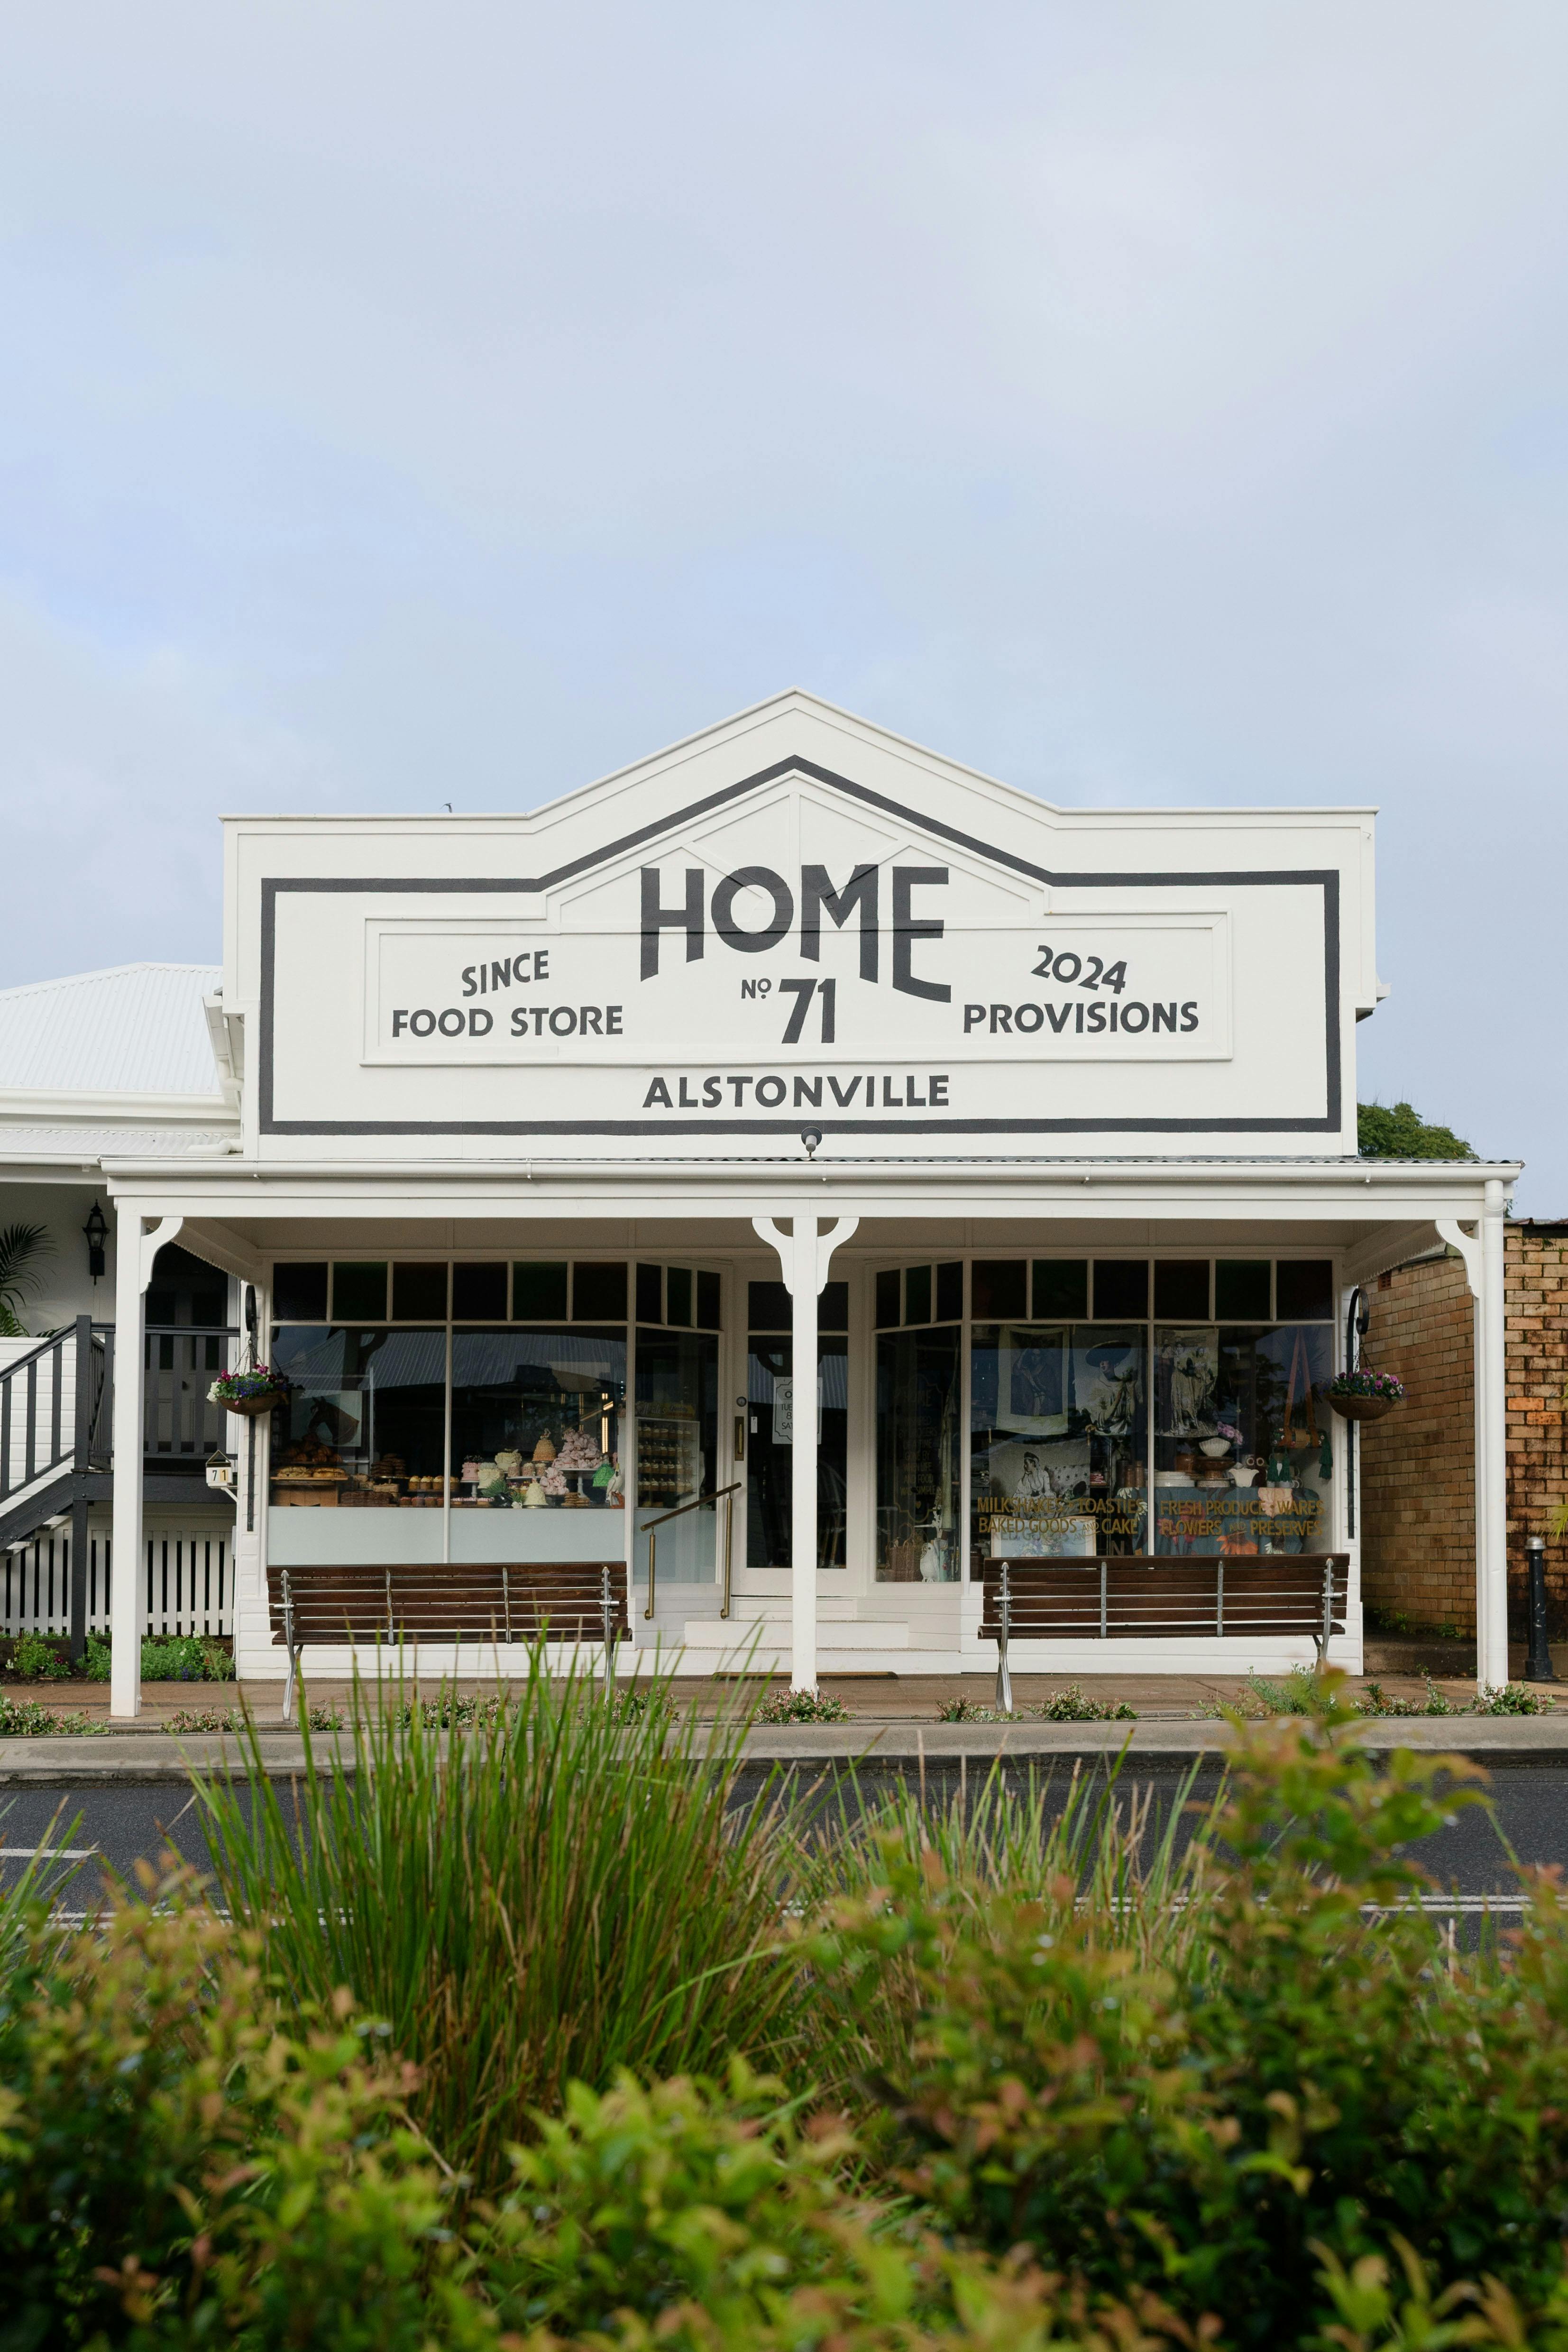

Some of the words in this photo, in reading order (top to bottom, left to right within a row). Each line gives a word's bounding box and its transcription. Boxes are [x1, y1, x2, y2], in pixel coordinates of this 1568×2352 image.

[641, 864, 951, 1003] HOME
[462, 951, 549, 997] SINCE
[1031, 945, 1127, 994] 2024
[393, 1009, 493, 1037] FOOD
[512, 1006, 623, 1036] STORE
[779, 979, 836, 1043] 71
[964, 1002, 1198, 1033] PROVISIONS
[642, 1075, 948, 1107] ALSTONVILLE
[916, 1485, 936, 1495] SIMPLE
[917, 1473, 934, 1483] FOOD
[977, 1497, 1063, 1513] MILKSHAKES
[1078, 1498, 1144, 1514] TOASTIES
[1160, 1501, 1202, 1515] FRESH
[1206, 1501, 1265, 1516] PRODUCE
[1277, 1500, 1325, 1516] WARES
[979, 1518, 1025, 1533] BAKED
[1028, 1518, 1077, 1533] GOODS
[1082, 1521, 1099, 1531] AND
[1101, 1518, 1138, 1534] CAKE
[1161, 1520, 1222, 1536] FLOWERS
[1229, 1521, 1247, 1531] AND
[1250, 1520, 1323, 1536] PRESERVES
